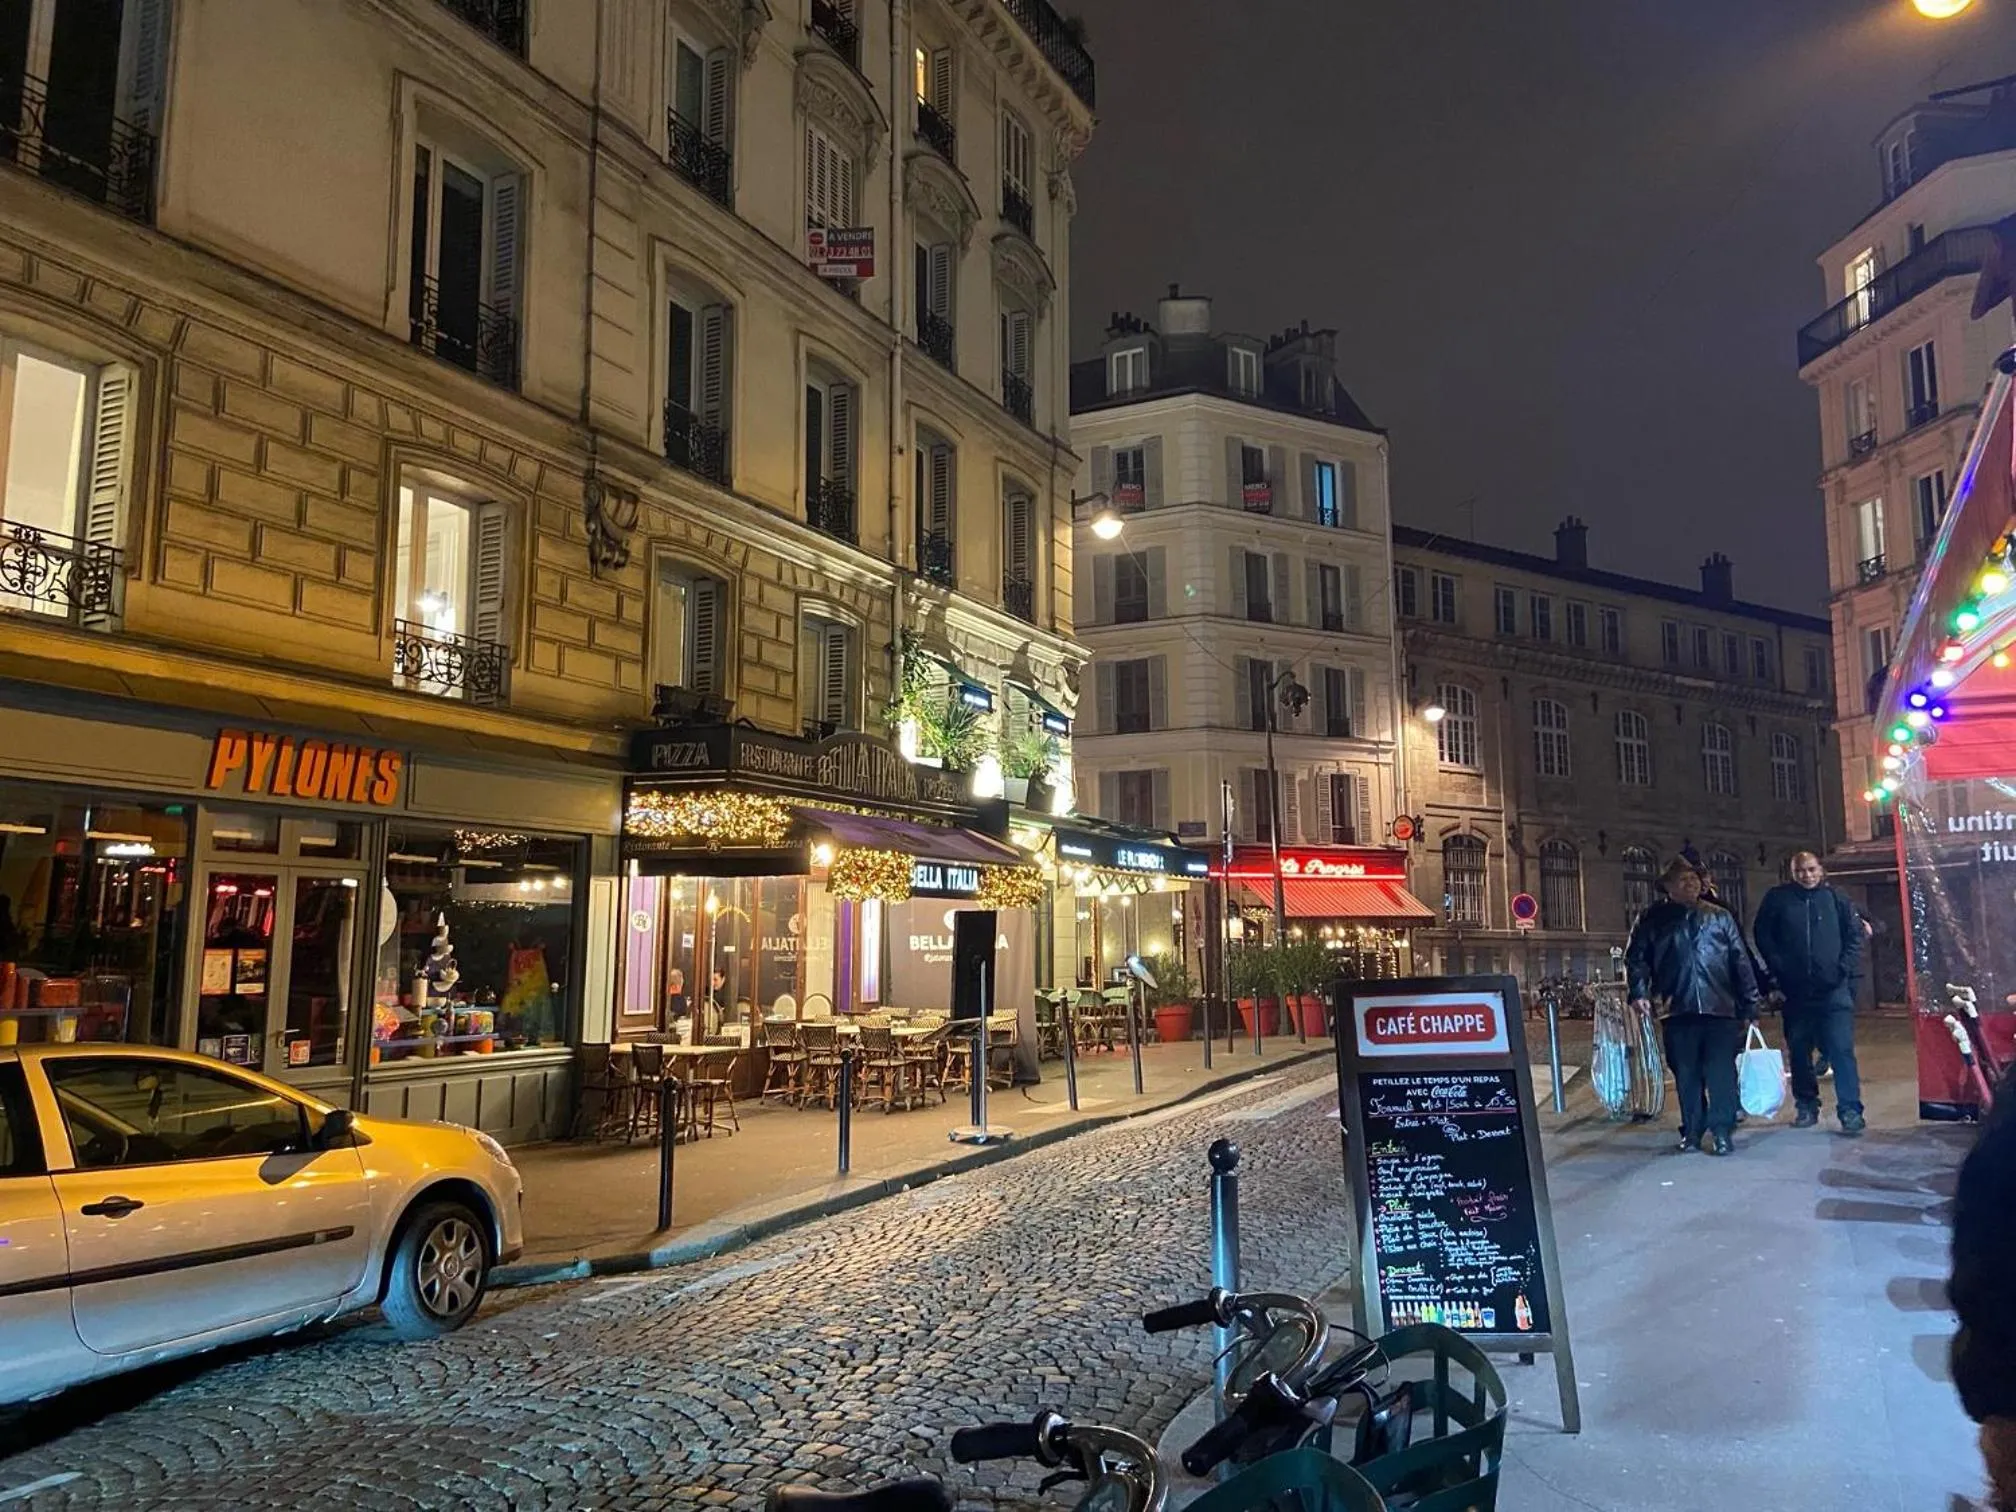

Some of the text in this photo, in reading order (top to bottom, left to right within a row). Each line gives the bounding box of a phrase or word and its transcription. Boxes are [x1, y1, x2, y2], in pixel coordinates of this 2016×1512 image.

[652, 741, 710, 768] PIZZA
[207, 729, 402, 806] PYLONES
[817, 742, 871, 794] BELLA
[871, 744, 919, 801] ITALIA
[762, 837, 804, 850] Pizzeria
[947, 868, 979, 890] ITALIA
[1376, 1012, 1486, 1036] CAFÉ CHAPPE
[1373, 1075, 1500, 1086] PETILLEZ LE TEMPS D'UN REPAS
[1406, 1088, 1429, 1096] AVEC
